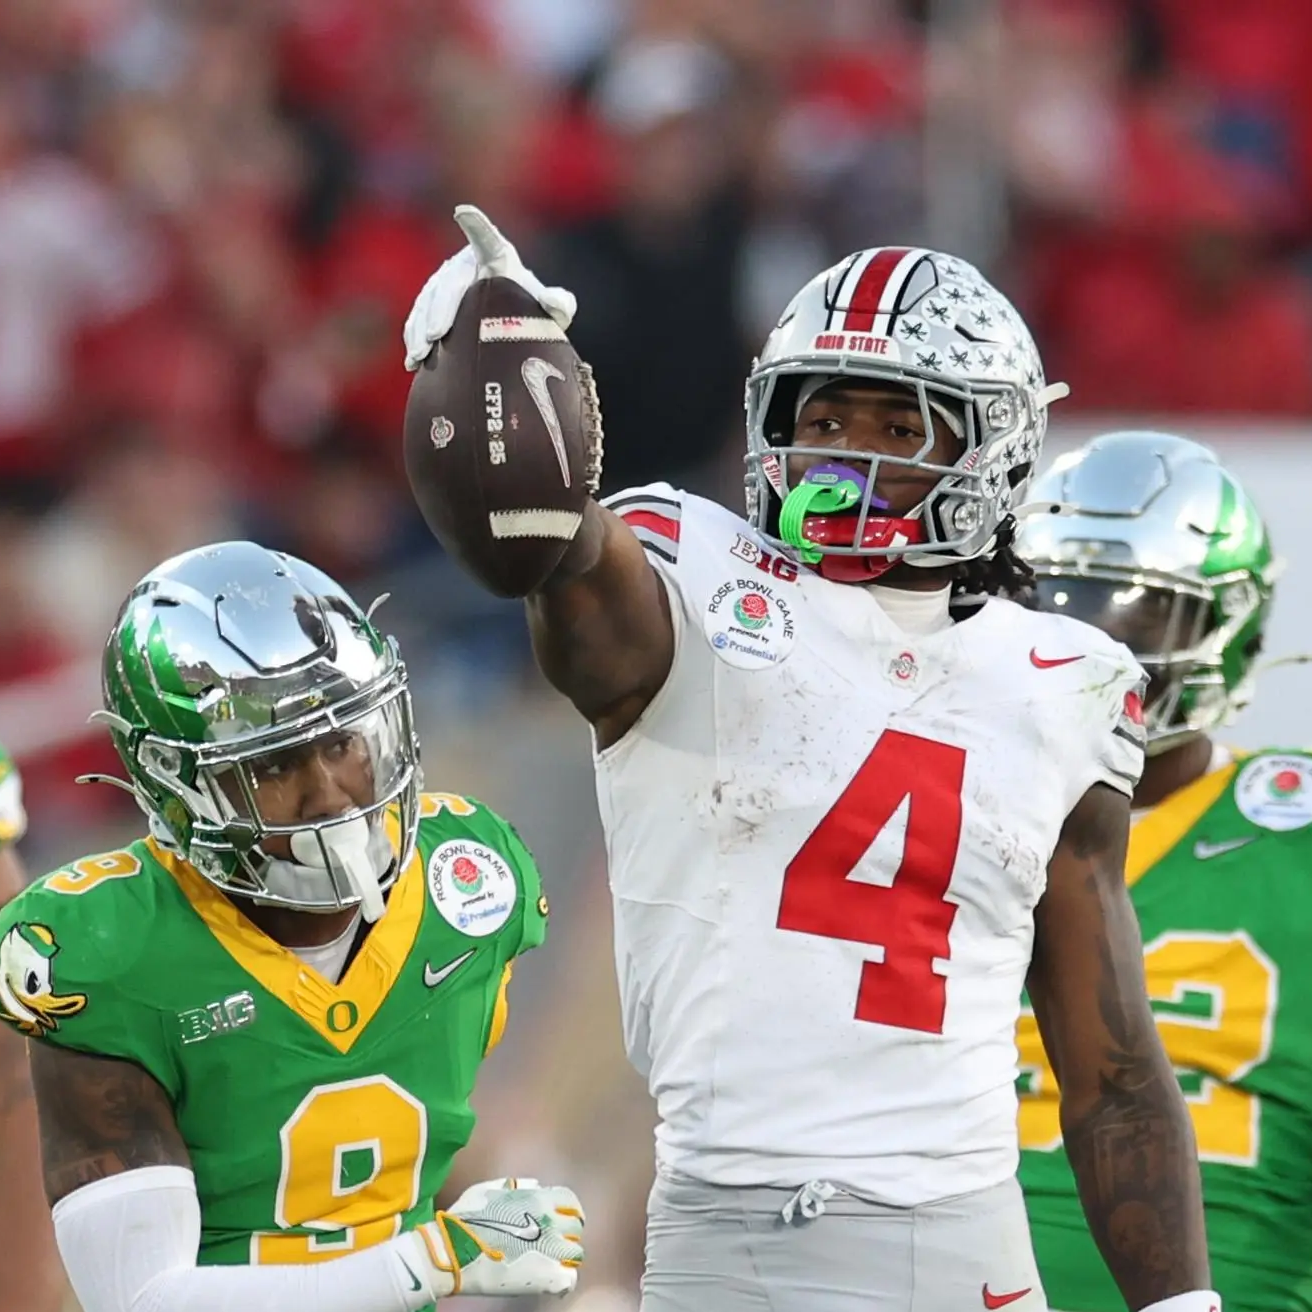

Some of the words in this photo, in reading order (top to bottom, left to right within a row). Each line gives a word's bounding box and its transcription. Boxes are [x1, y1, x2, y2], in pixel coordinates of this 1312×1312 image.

[814, 334, 846, 350] OHIO
[847, 336, 889, 354] STATE
[708, 582, 735, 614] ROSE
[736, 578, 775, 601] BOWL
[775, 598, 794, 640] GAME
[727, 626, 761, 640] presented
[728, 640, 778, 661] Prudential
[438, 844, 472, 863] BOWL
[473, 848, 508, 881] GAME
[432, 863, 446, 903] ROSE
[775, 727, 968, 1034] 4
[250, 1073, 428, 1265] 9
